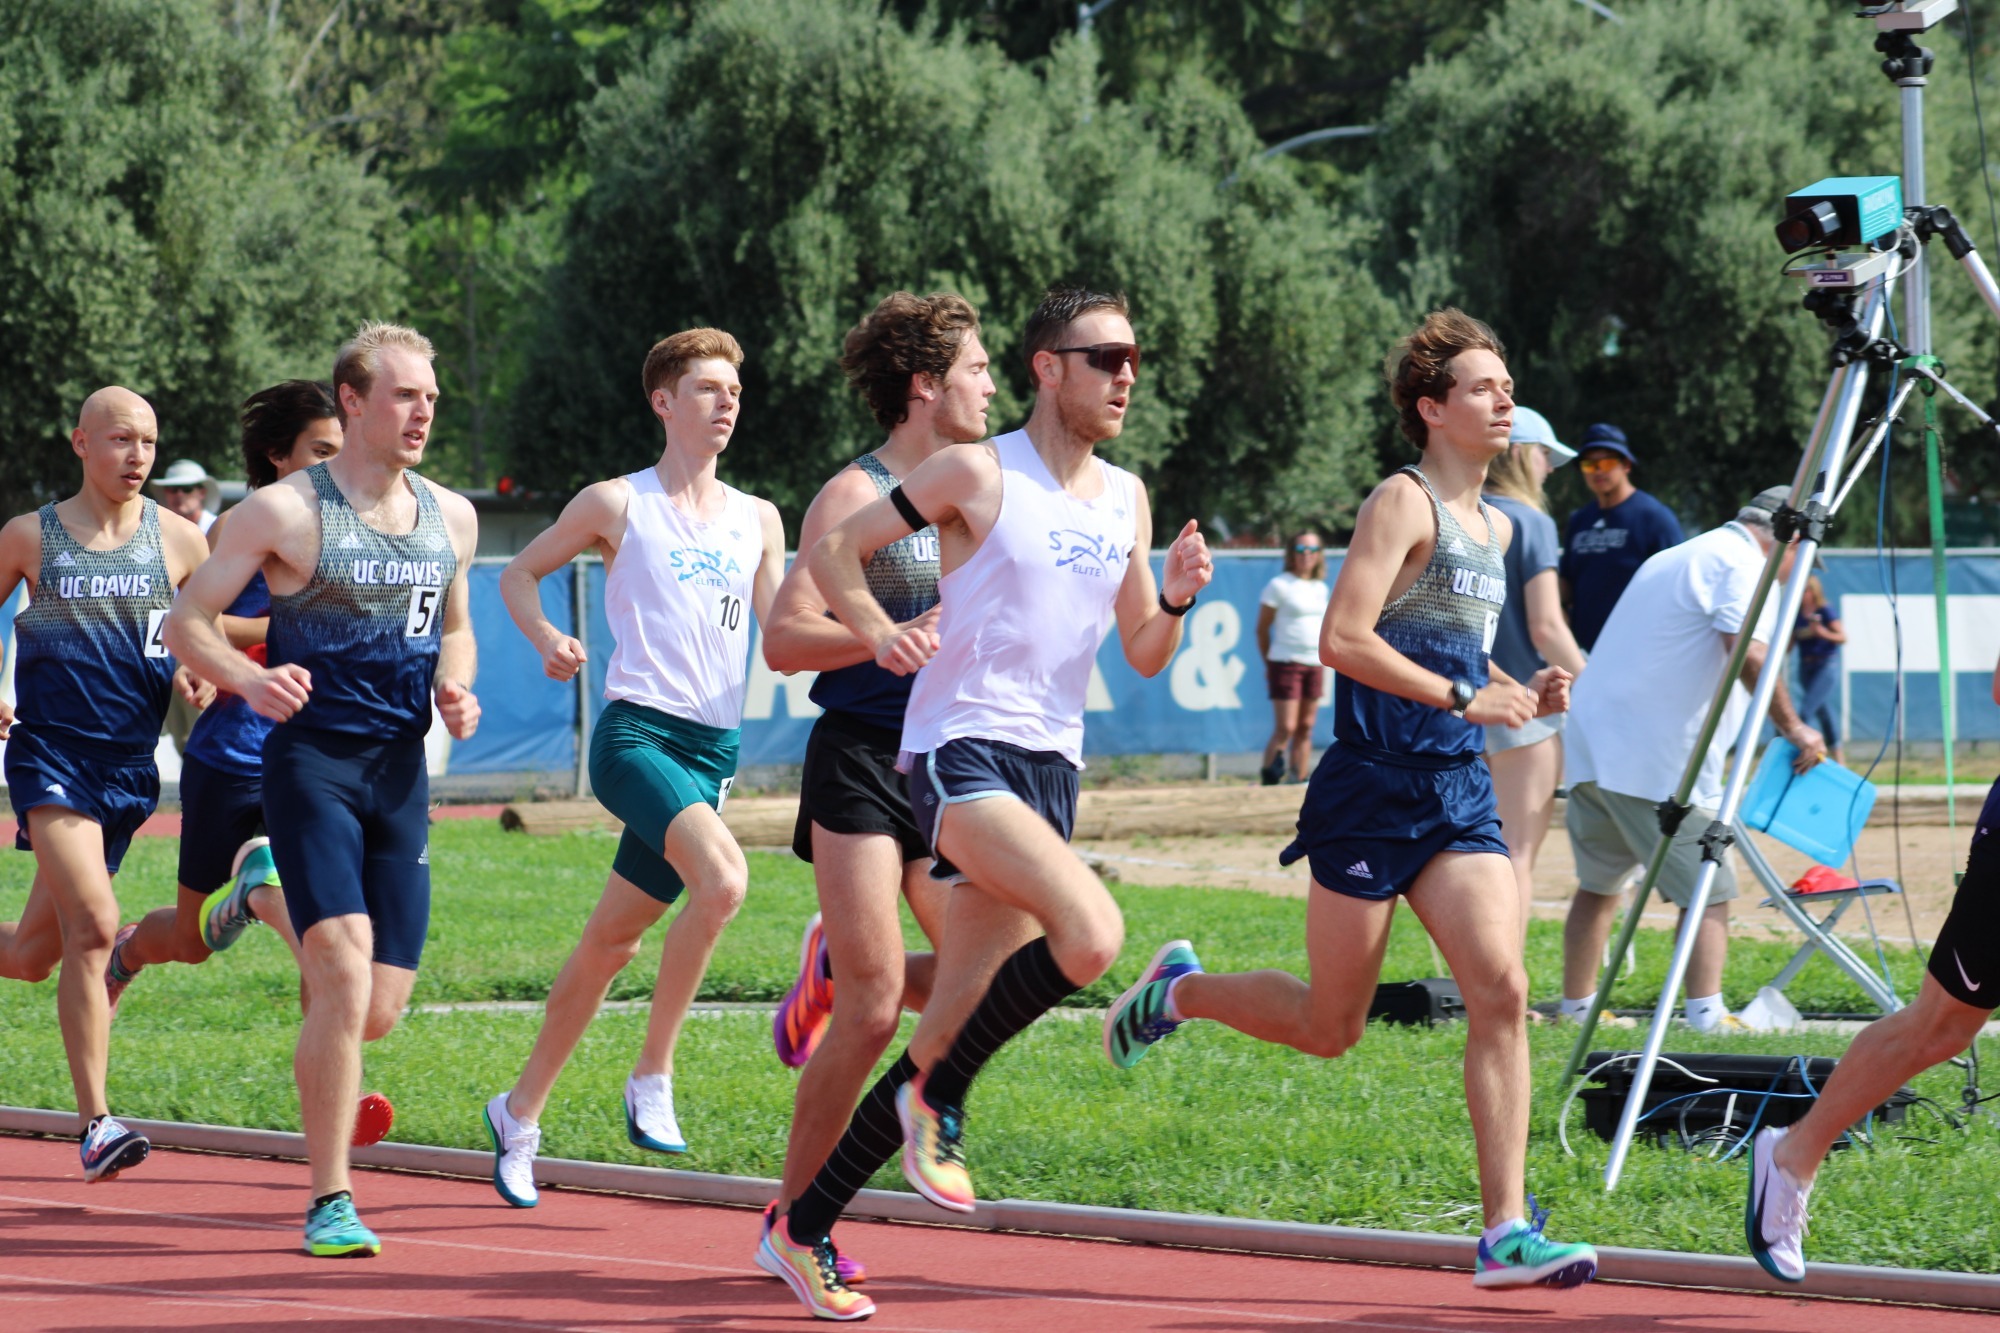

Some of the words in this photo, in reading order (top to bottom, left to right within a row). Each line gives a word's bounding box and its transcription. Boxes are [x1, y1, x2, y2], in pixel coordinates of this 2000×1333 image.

[912, 536, 939, 562] UC
[353, 559, 380, 584] UC
[385, 560, 442, 586] DAVIS
[695, 577, 723, 587] ELITE
[1072, 563, 1102, 577] ELITE
[1452, 567, 1478, 597] UC
[59, 575, 86, 599] UC
[90, 574, 152, 598] DAVIS
[413, 591, 436, 634] 5
[720, 594, 741, 631] 10
[1170, 600, 1246, 710] &
